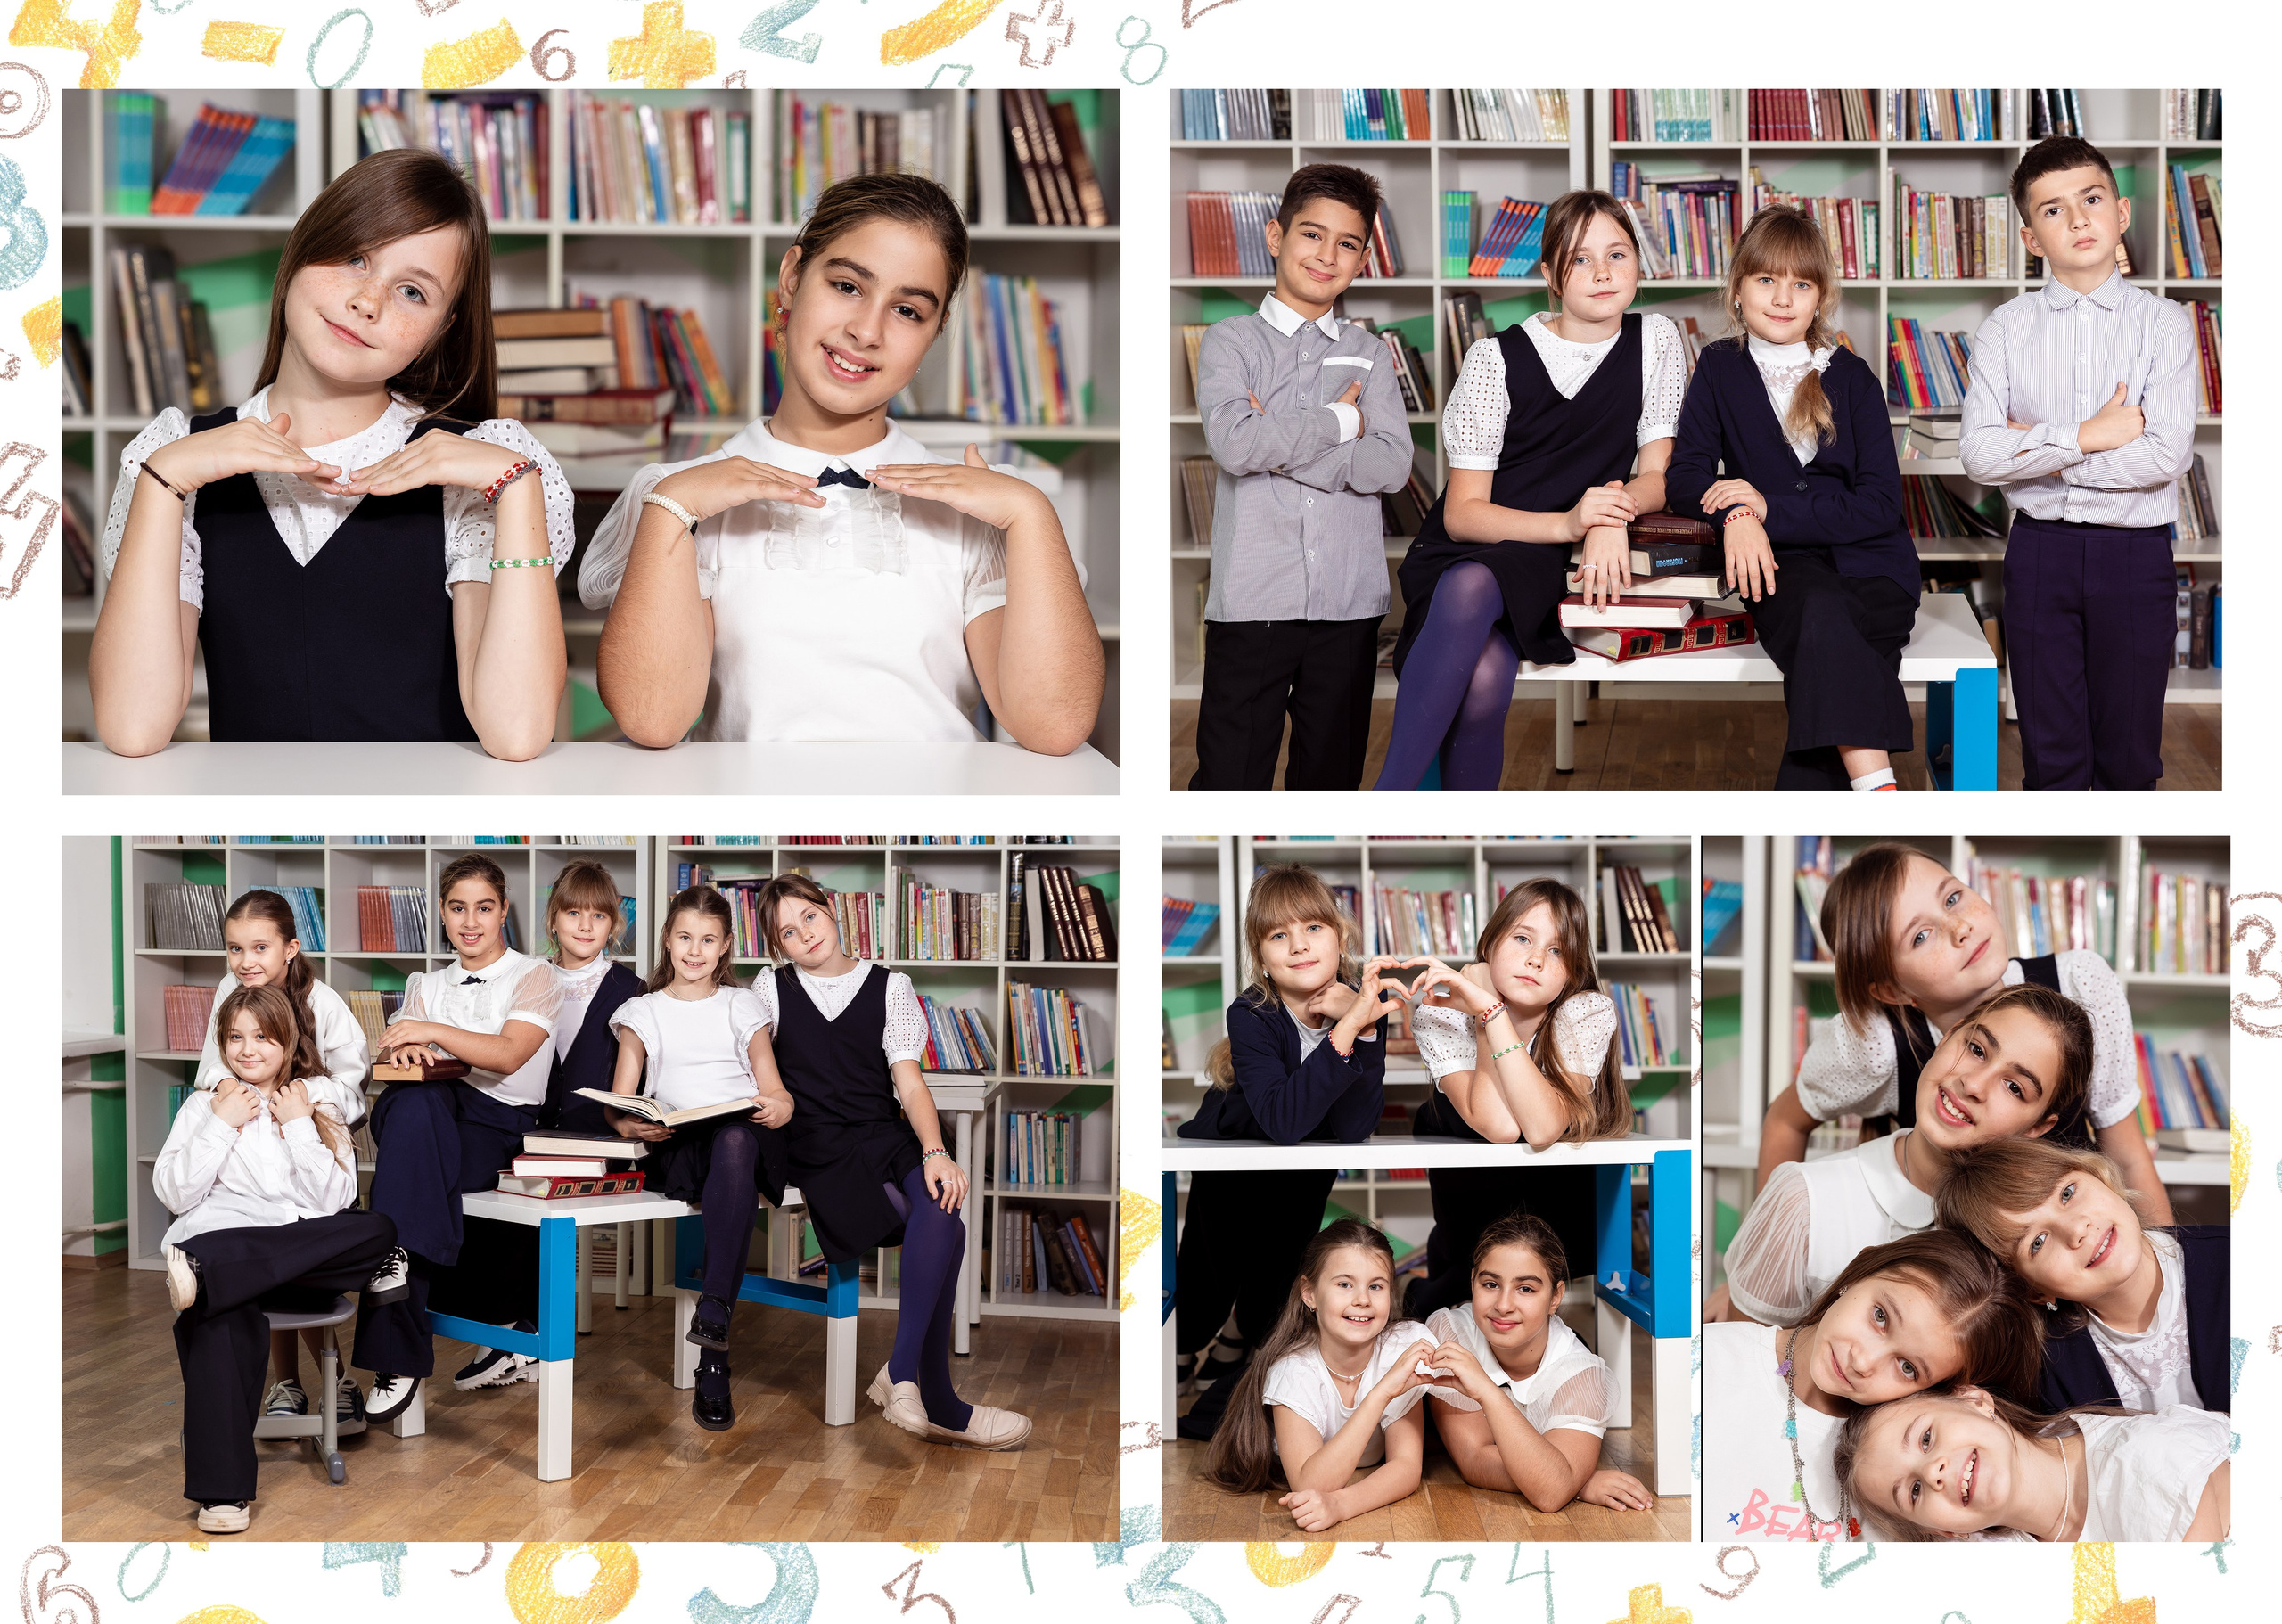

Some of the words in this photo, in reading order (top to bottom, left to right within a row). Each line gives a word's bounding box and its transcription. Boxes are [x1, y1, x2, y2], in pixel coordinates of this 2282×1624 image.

[530, 29, 576, 82] 6
[1115, 15, 1168, 86] 8
[1734, 1487, 1842, 1542] BEAR
[1699, 1545, 1761, 1601] 9
